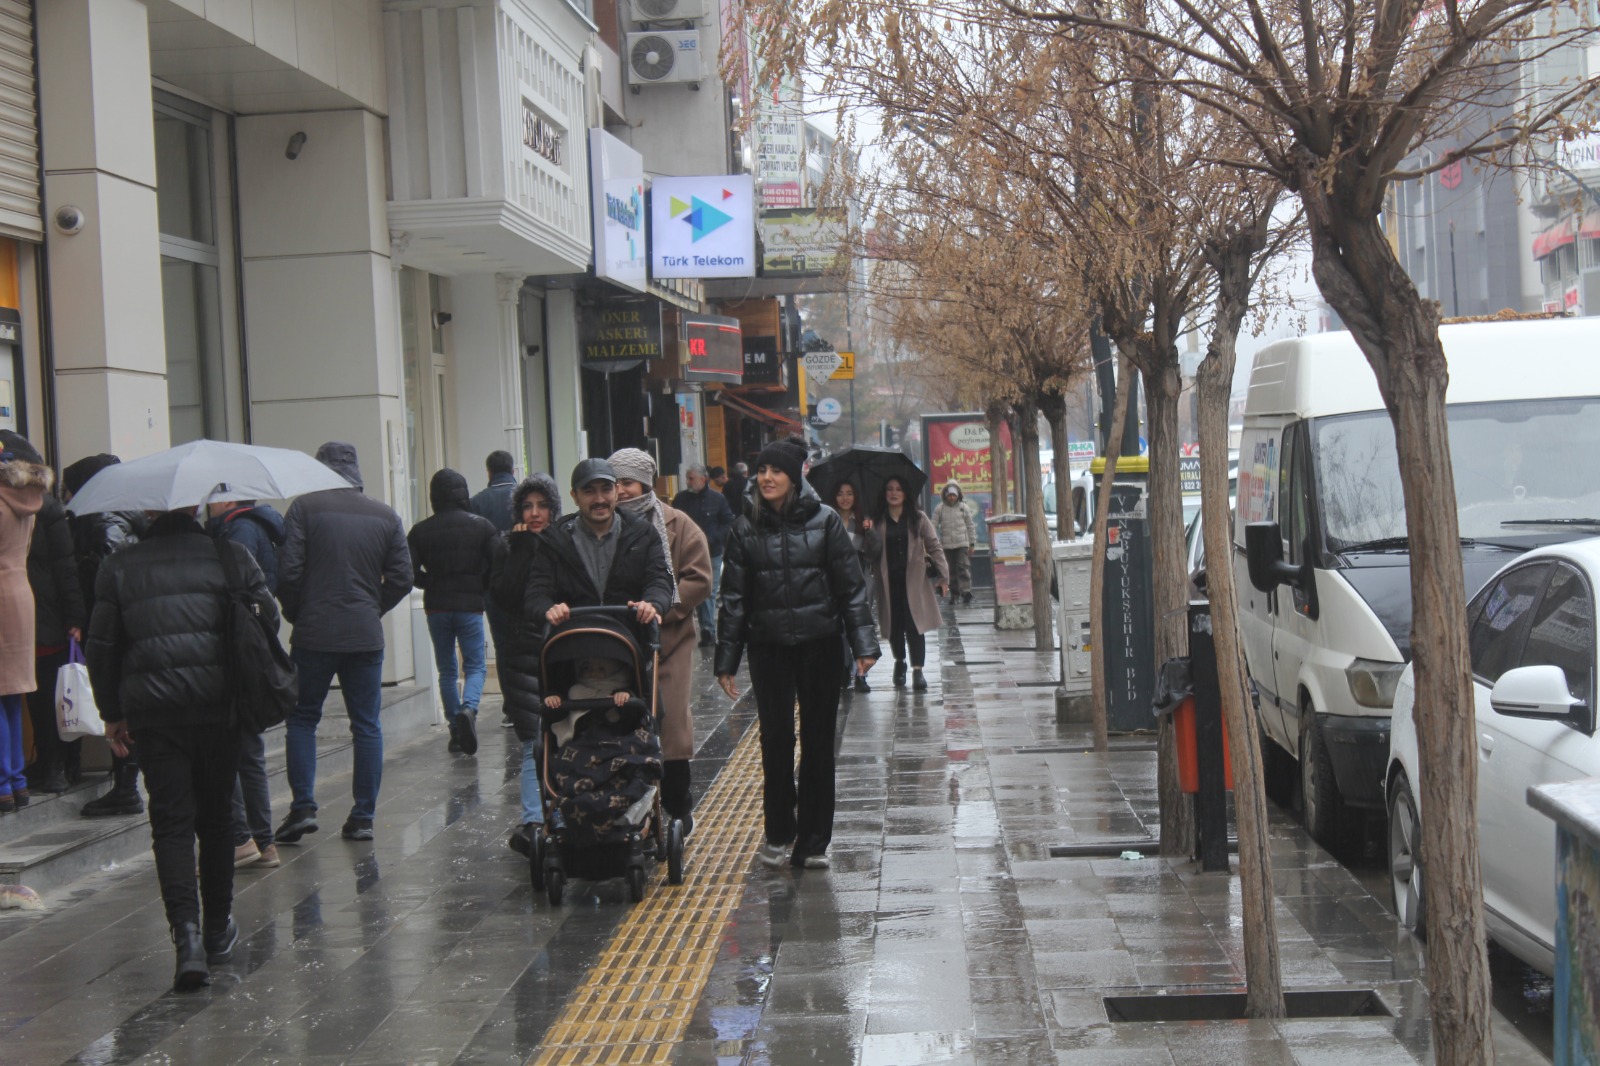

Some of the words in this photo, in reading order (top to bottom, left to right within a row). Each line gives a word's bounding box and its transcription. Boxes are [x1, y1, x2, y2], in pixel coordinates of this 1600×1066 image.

[662, 256, 688, 266] Türk
[693, 255, 744, 266] Telekom
[587, 344, 659, 357] MALZEME
[805, 354, 836, 364] GÖZDE
[1126, 667, 1136, 700] BLD
